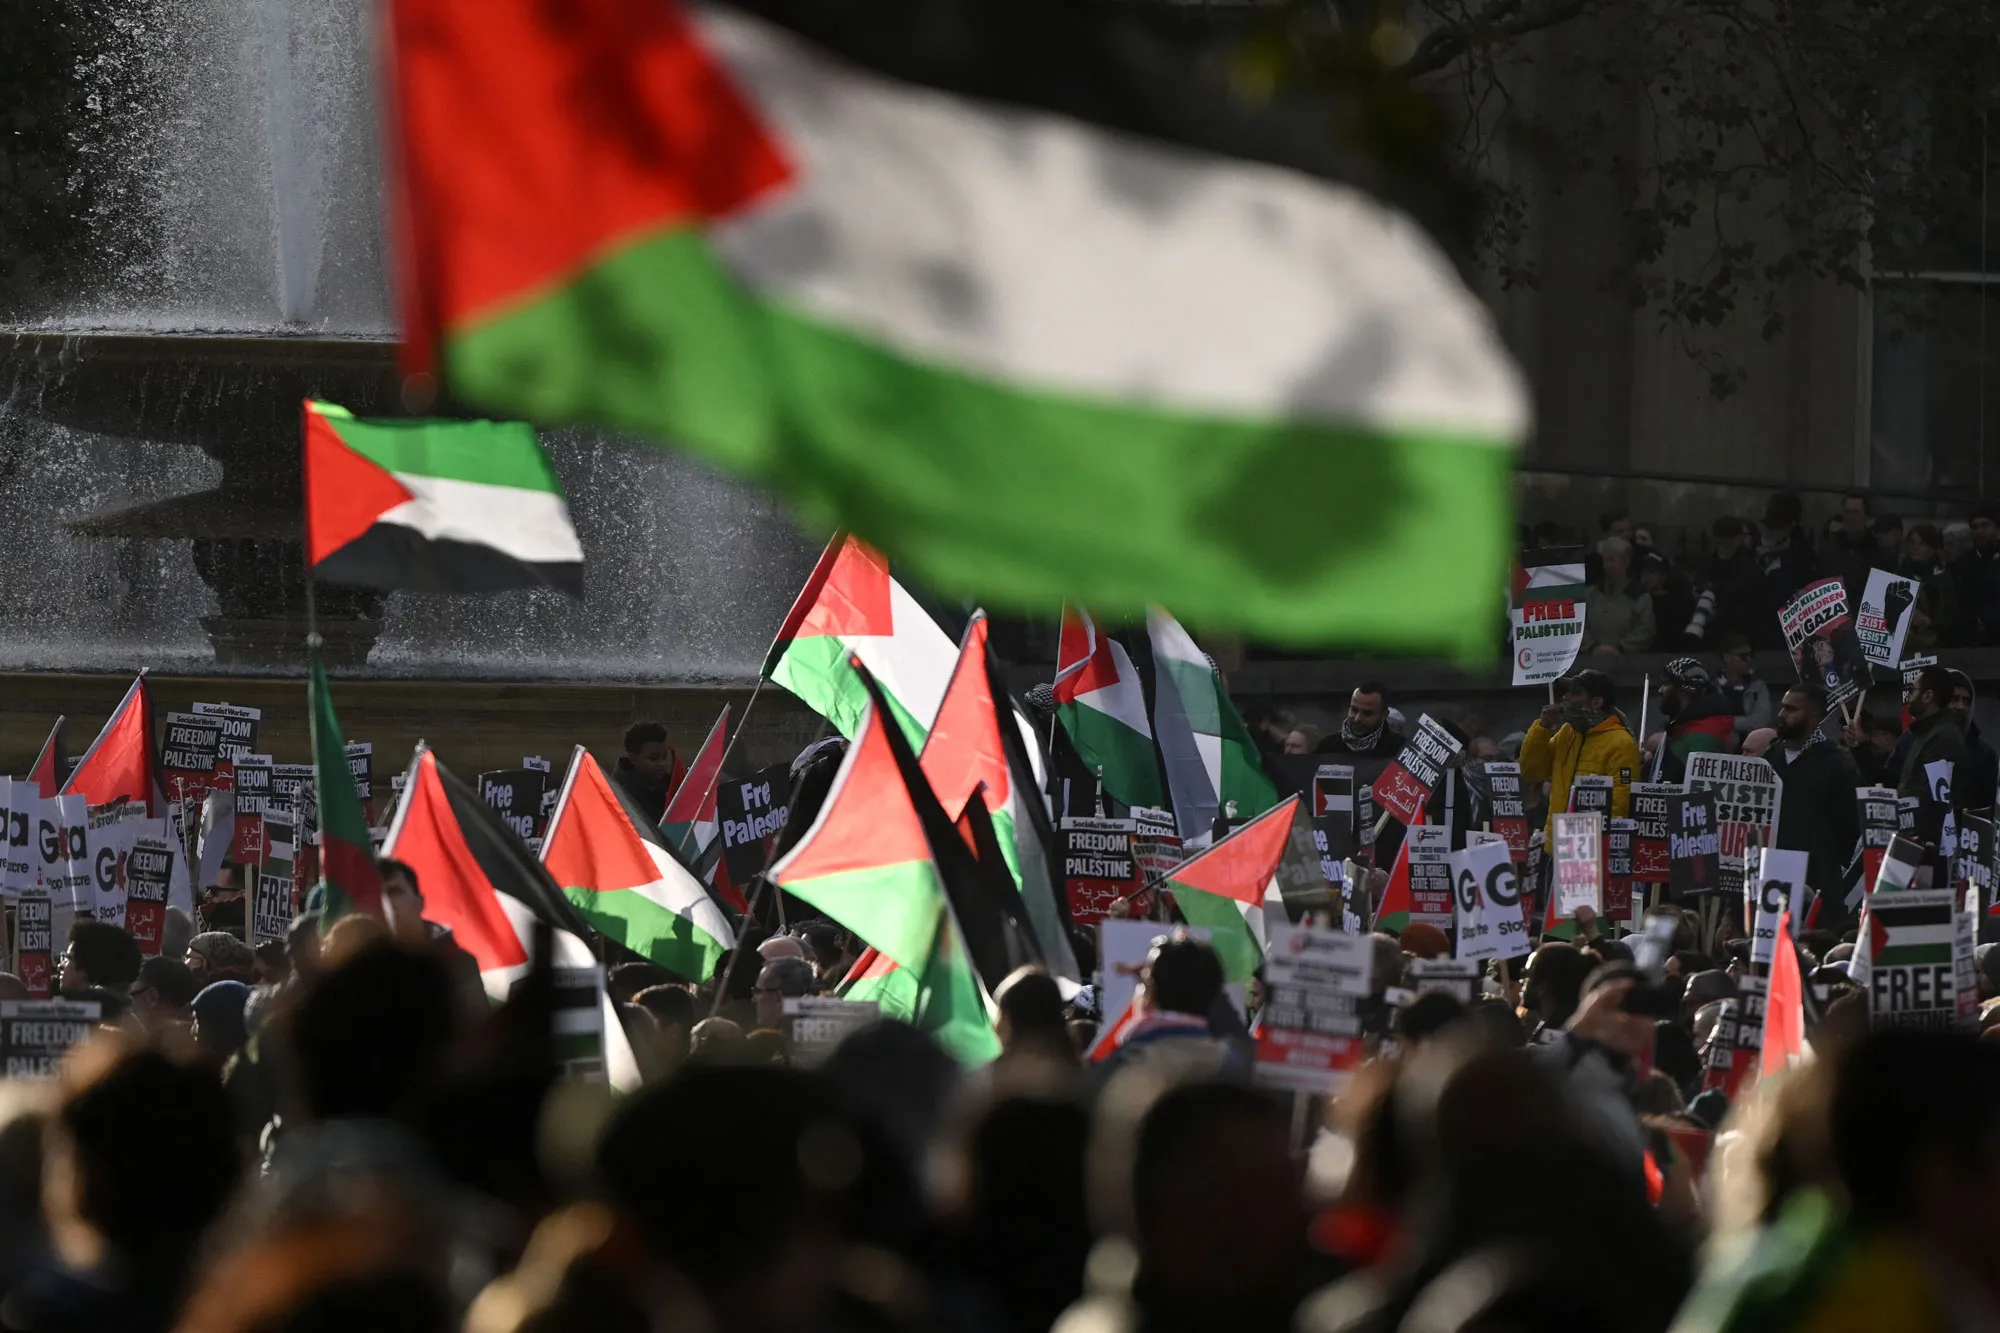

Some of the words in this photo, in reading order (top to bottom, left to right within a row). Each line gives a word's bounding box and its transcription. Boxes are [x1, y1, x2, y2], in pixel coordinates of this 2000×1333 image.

[1523, 598, 1575, 623] FREE
[1782, 603, 1801, 623] STOP
[1800, 583, 1840, 606] KILLING
[1784, 617, 1798, 634] THE
[1799, 590, 1844, 621] CHILDREN
[1788, 628, 1803, 647] IN
[1804, 602, 1846, 635] GAZA
[1859, 615, 1886, 630] EXIST.
[170, 727, 217, 746] FREEDOM
[163, 750, 215, 770] PALESTINE
[1691, 757, 1718, 779] FREE
[1719, 760, 1776, 785] PALESTINE
[485, 780, 513, 808] Free
[1069, 833, 1128, 852] FREEDOM
[1960, 828, 1979, 853] ee
[1066, 858, 1131, 878] PALESTINE
[1872, 966, 1954, 1012] FREE
[10, 1021, 91, 1046] FREEDOM
